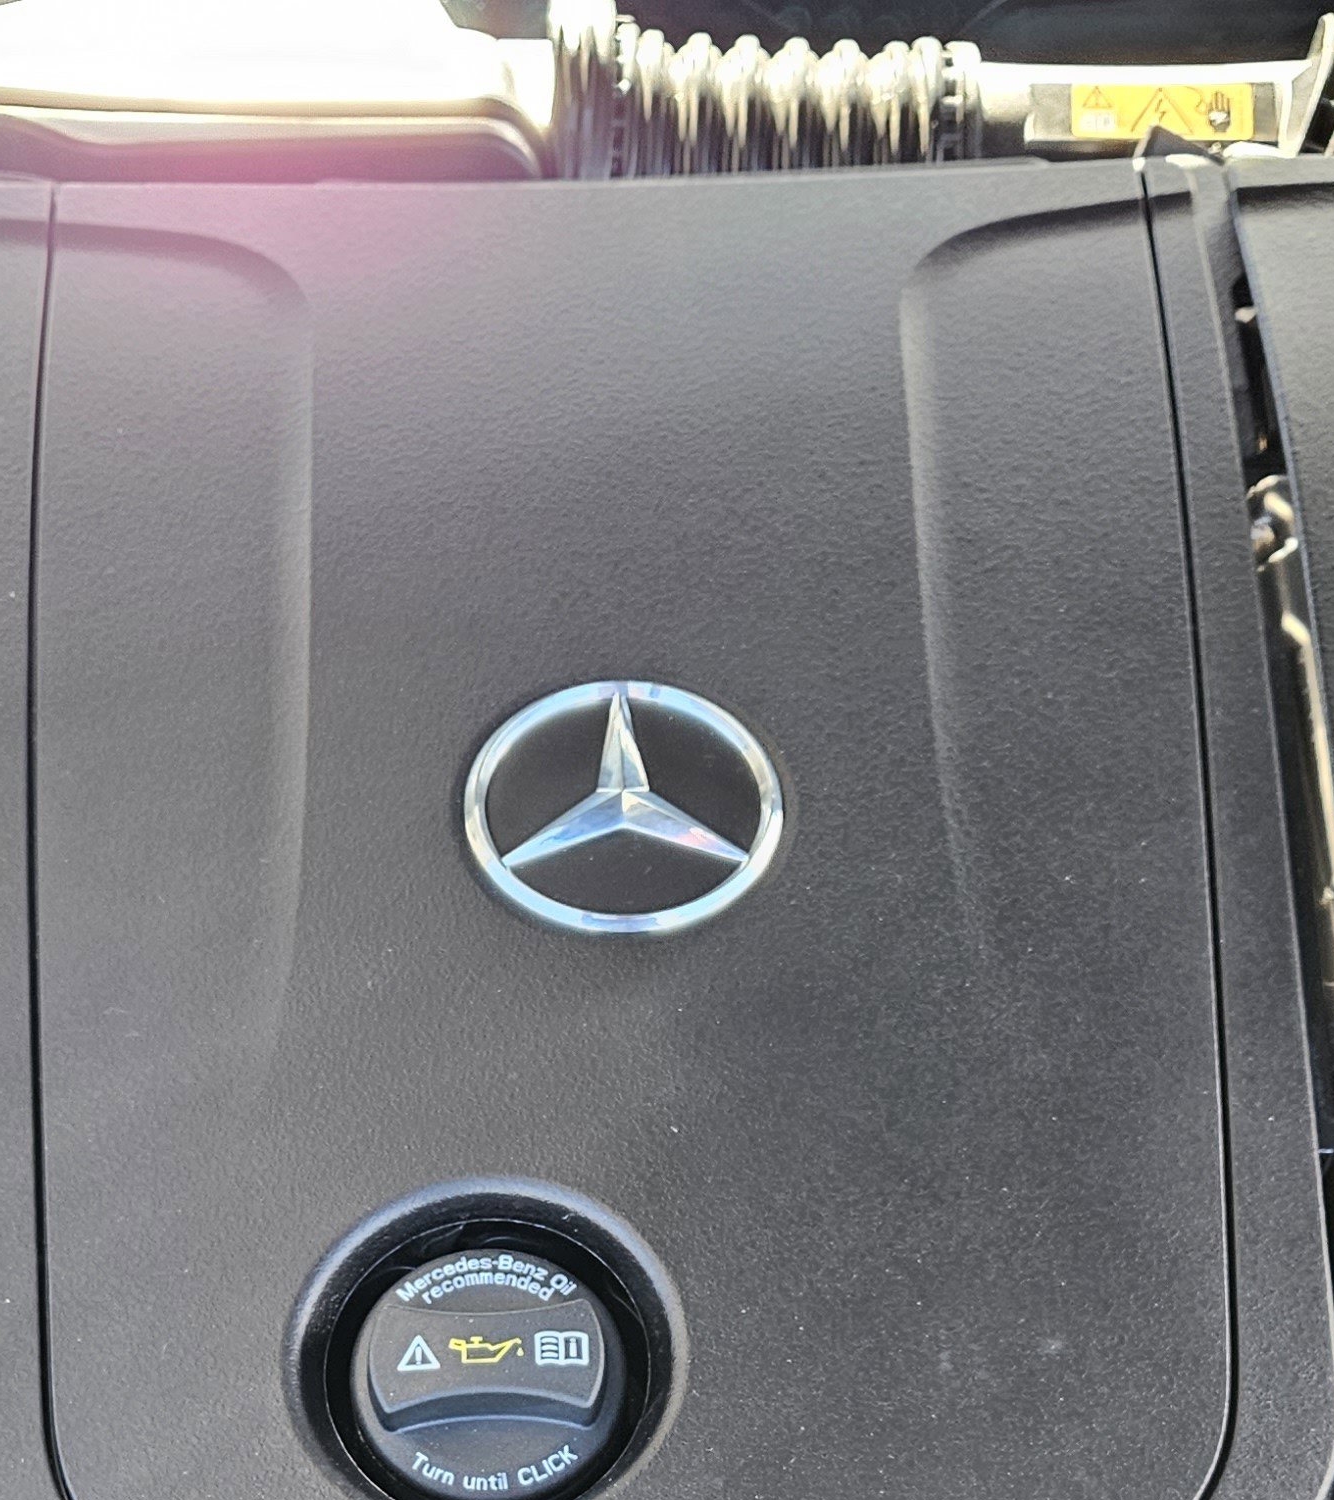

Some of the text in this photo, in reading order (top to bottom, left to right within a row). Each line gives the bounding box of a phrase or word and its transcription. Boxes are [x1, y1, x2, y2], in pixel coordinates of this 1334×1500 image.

[395, 1254, 578, 1302] Mercedes-Benz Oil
[421, 1271, 556, 1304] recommended
[410, 1443, 580, 1491] Turn until CLICK
